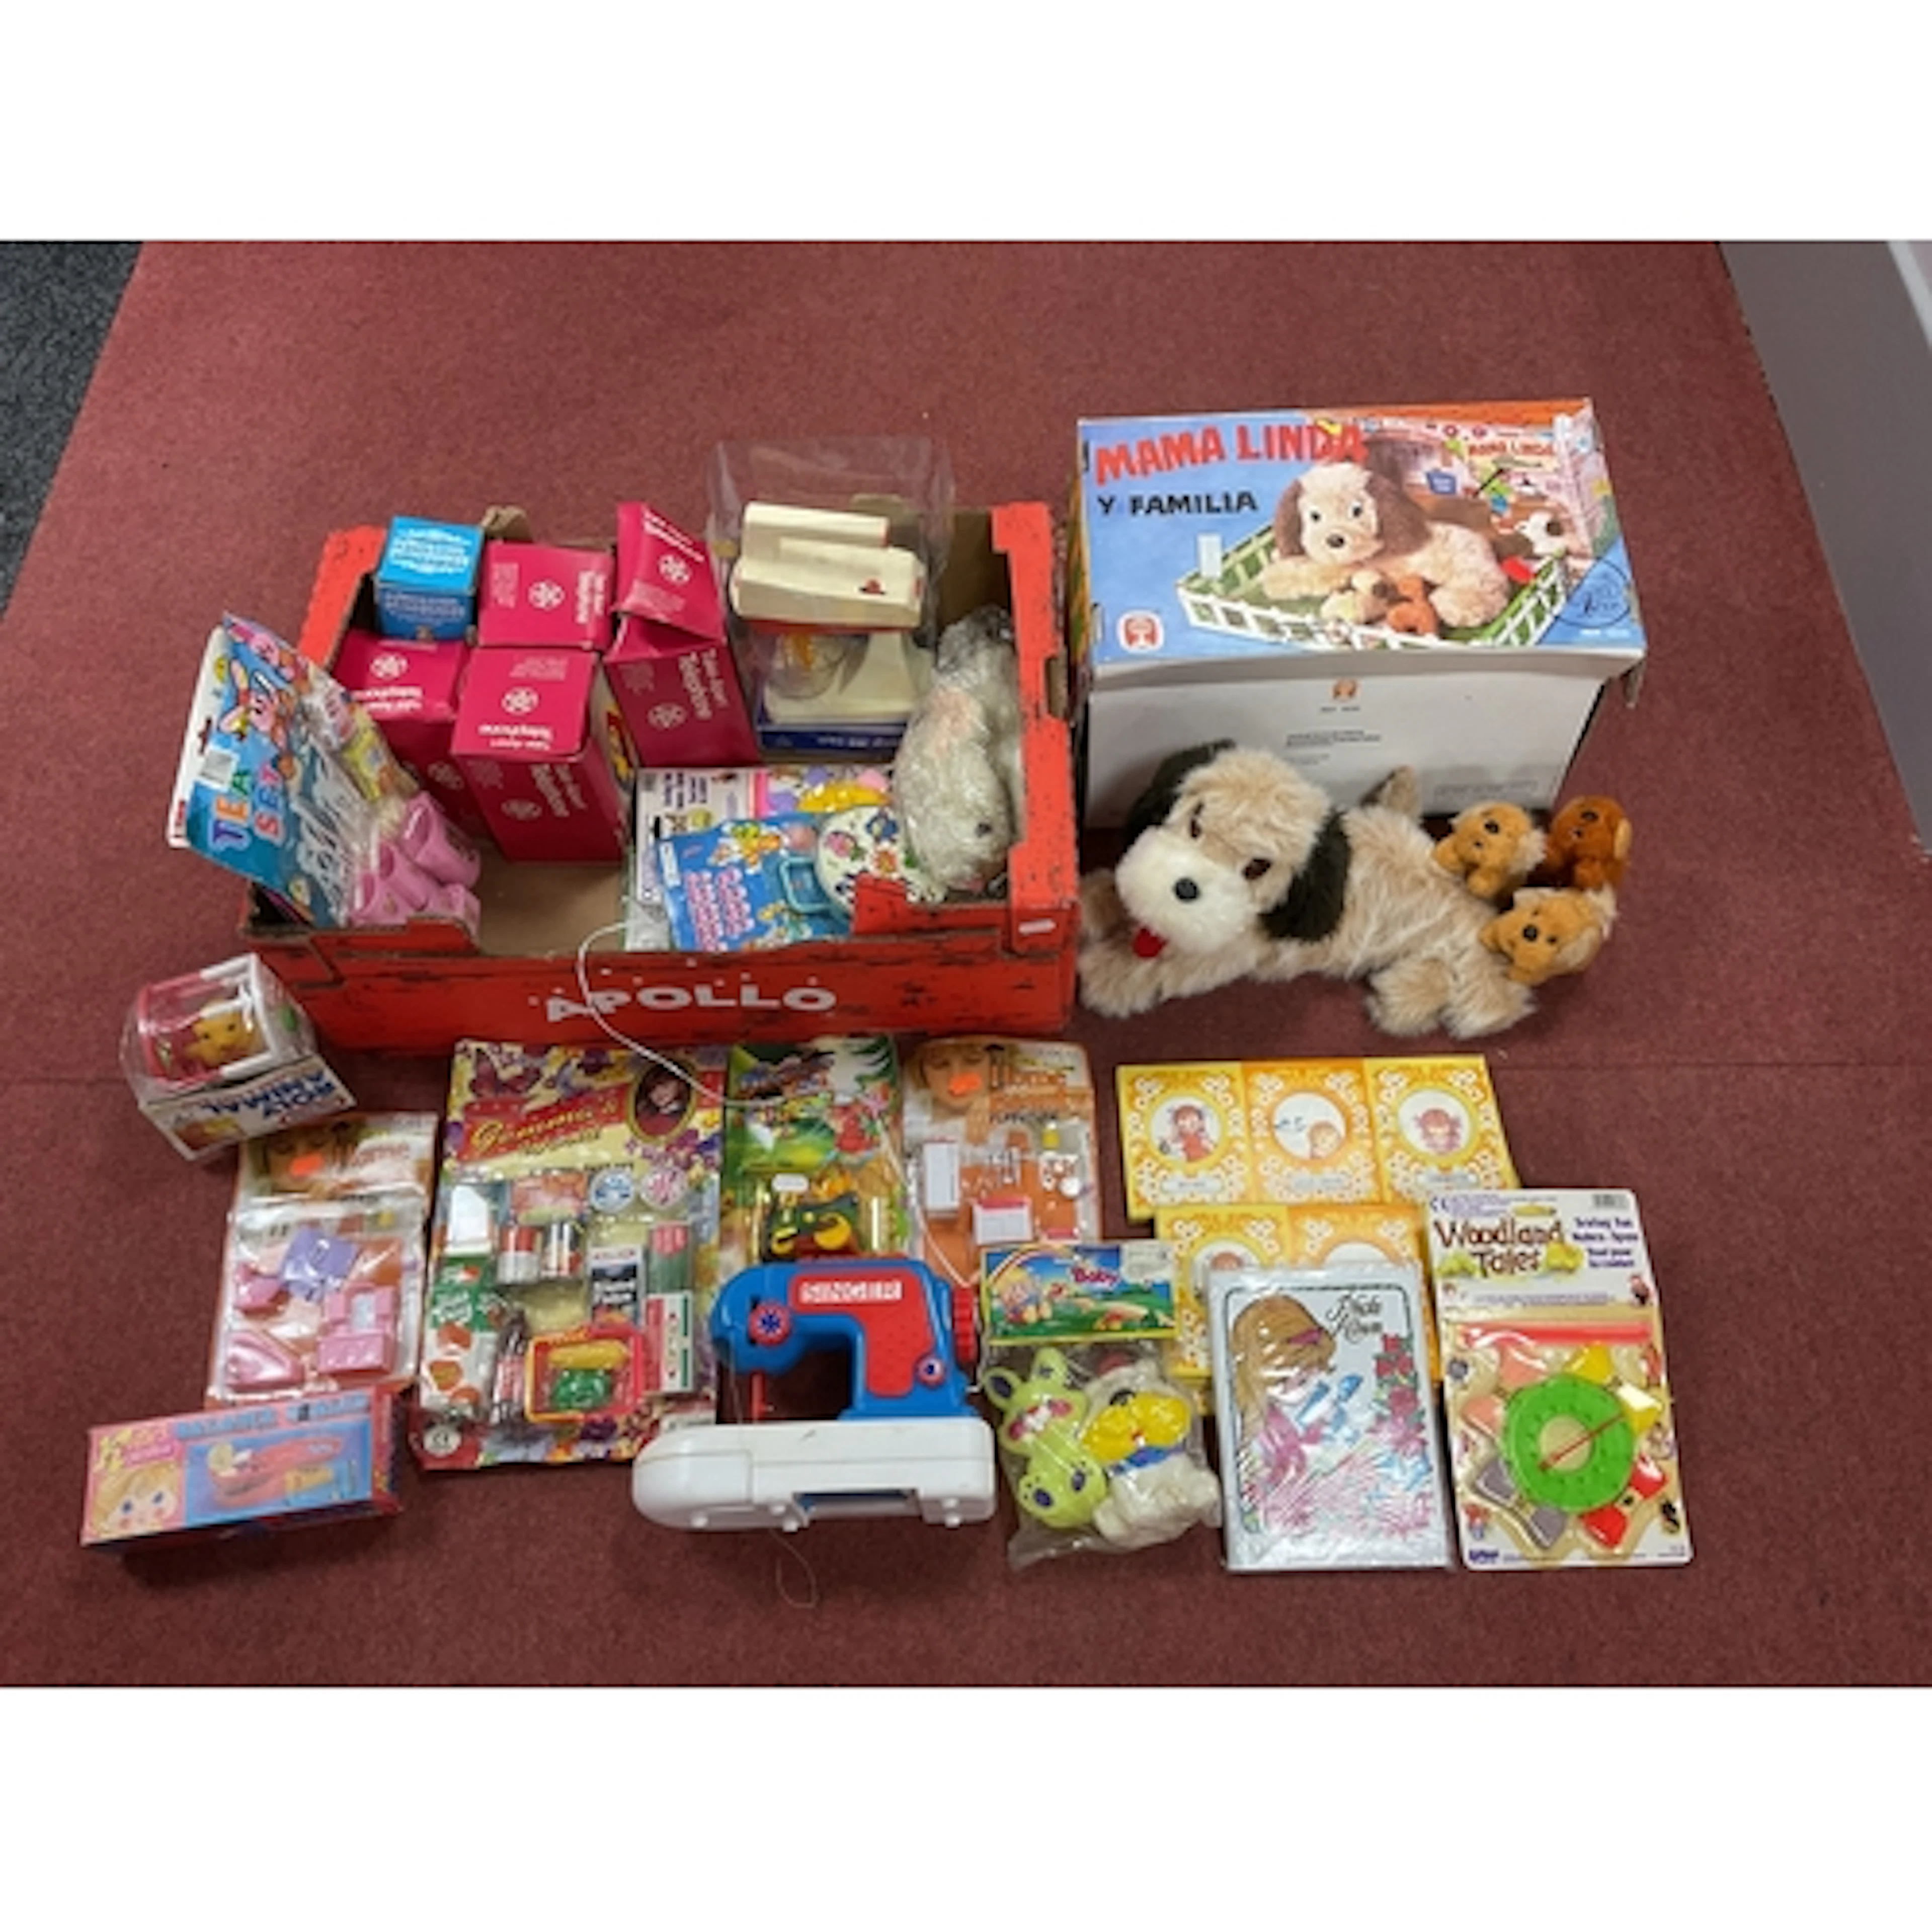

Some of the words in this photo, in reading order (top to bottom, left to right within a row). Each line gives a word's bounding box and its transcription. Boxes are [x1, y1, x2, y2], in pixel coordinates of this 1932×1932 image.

[1097, 426, 1227, 486] MAMA
[1237, 424, 1369, 462] LINDA
[1098, 496, 1116, 515] Y
[1130, 491, 1258, 515] FAMILIA
[208, 770, 250, 850] TEA
[254, 756, 287, 840] SET
[546, 984, 837, 1023] APOLLO
[201, 1071, 325, 1114] ANIMAL
[1433, 1215, 1565, 1248] Woodland
[1470, 1248, 1541, 1278] Tales
